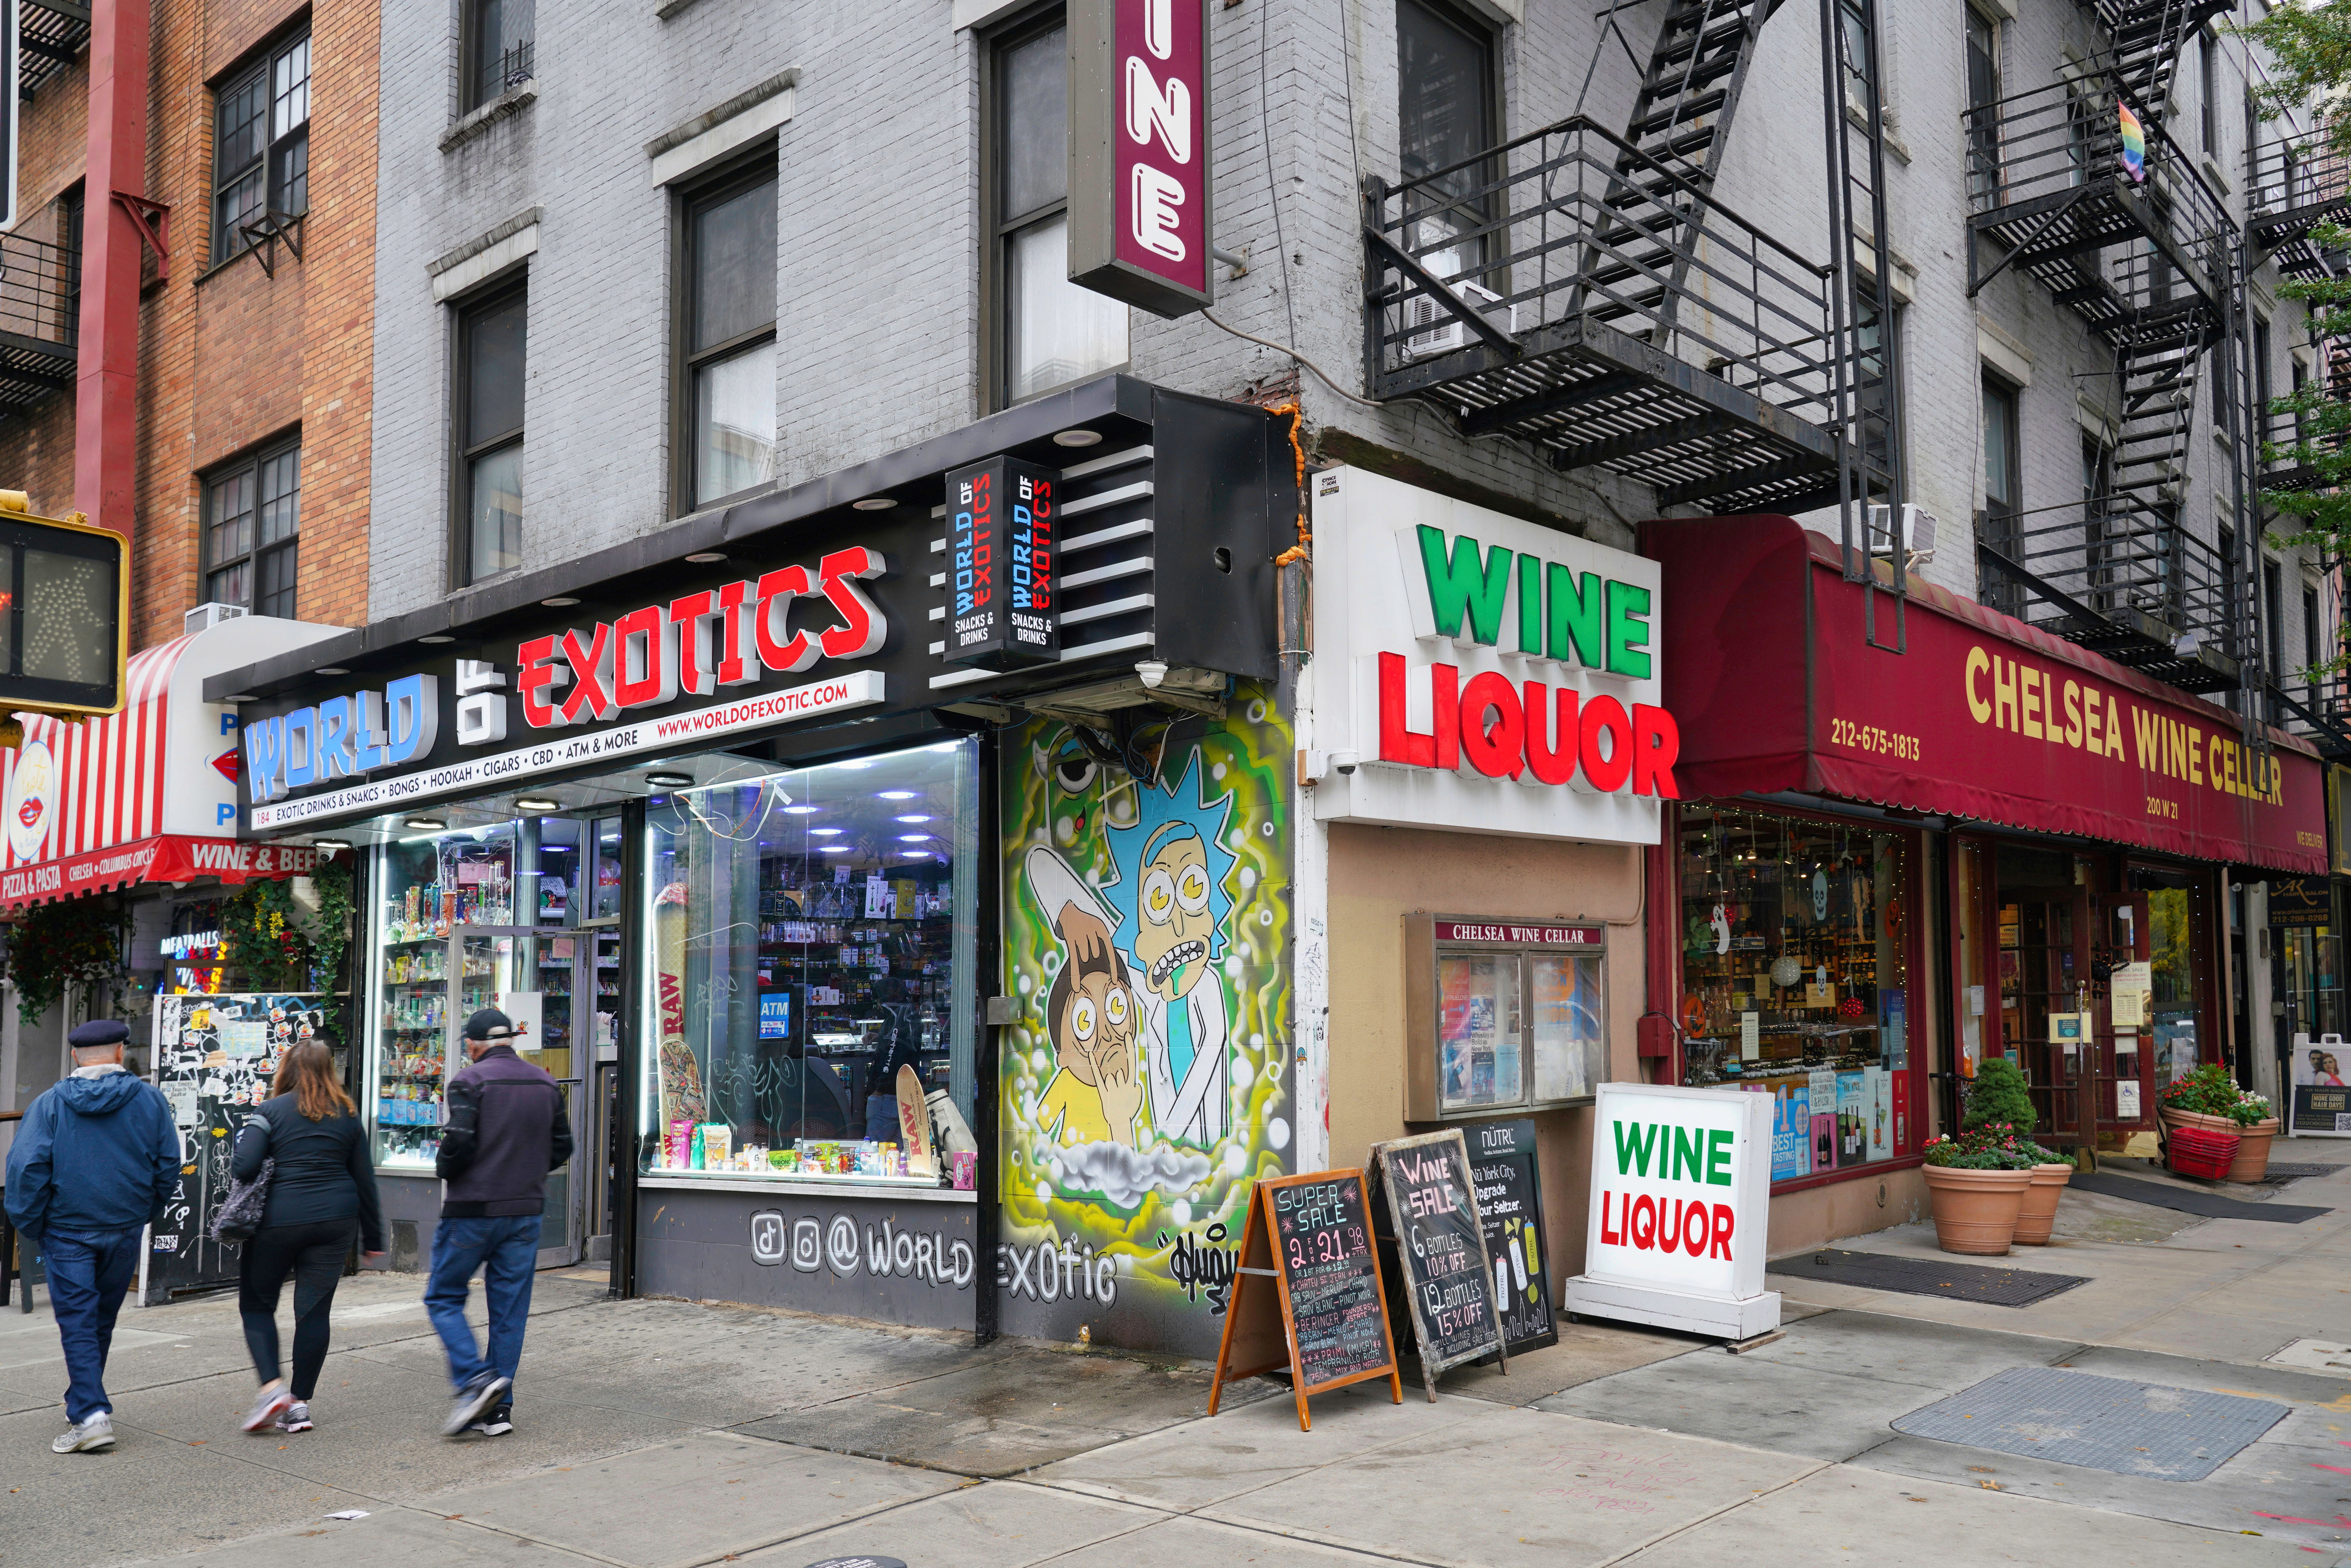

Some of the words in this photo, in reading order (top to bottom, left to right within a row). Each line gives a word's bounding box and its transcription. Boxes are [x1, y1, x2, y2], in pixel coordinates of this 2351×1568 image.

[1019, 475, 1032, 500] OF
[1322, 475, 1337, 484] SPACE
[960, 482, 972, 505] OF
[973, 473, 992, 607] EXOTICS
[1032, 479, 1051, 610] EXOTICS
[956, 511, 975, 616] WORLD
[1013, 504, 1032, 608] WORLD
[1416, 524, 1650, 679] WINE
[955, 614, 985, 633] SNACKS
[987, 612, 994, 625] &
[1012, 612, 1044, 630] SNACKS
[1045, 619, 1052, 632] &
[517, 546, 887, 728] EXOTICS
[960, 628, 988, 646] DRINKS
[1017, 628, 1046, 646] DRINKS
[657, 682, 848, 739] WWW.WORLDOFEXOTIC.COM
[244, 674, 438, 805] WORLD
[456, 658, 507, 746] OF
[1378, 651, 1680, 799] LIQUOR
[1965, 646, 2125, 762] CHELSEA
[2132, 705, 2202, 785] WINE
[2209, 735, 2283, 806] CELLAR
[1831, 718, 1920, 761] 212-675-1813
[256, 811, 270, 825] 184
[277, 802, 304, 822] EXOTIC
[307, 796, 337, 817] DRINKS
[338, 795, 345, 806] &
[347, 788, 379, 806] SNAKCS
[389, 779, 420, 798] BONGS
[430, 767, 473, 788] HOOKAH
[483, 756, 520, 776] CIGARS
[531, 751, 554, 766] CBD
[565, 741, 590, 759] ATM
[592, 738, 601, 753] &
[604, 729, 638, 749] MORE
[2146, 796, 2161, 816] 200
[2162, 800, 2170, 817] W
[2171, 802, 2178, 820] 21
[2296, 830, 2305, 846] WE
[2305, 832, 2323, 849] DELIVER
[193, 843, 252, 870] WINE
[256, 848, 273, 871] &
[280, 847, 324, 873] BEE
[3, 873, 26, 899] PIZZA
[27, 872, 35, 893] &
[36, 865, 61, 892] PASTA
[69, 862, 93, 882] CHELSEA
[99, 853, 131, 875] COLUMBUS
[132, 848, 155, 868] CIRCLE
[2272, 907, 2328, 915] www.arhairsalon.com
[2272, 914, 2328, 923] 212-206-0268
[1453, 924, 1505, 941] CHELSEA
[1511, 927, 1540, 942] WINE
[1545, 929, 1585, 943] CELLAR
[659, 971, 685, 1036] RAW
[761, 1002, 788, 1016] ATM
[1842, 1081, 1850, 1092] THE
[1774, 1087, 1789, 1132] #1
[1814, 1097, 1818, 1107] &
[900, 1100, 922, 1157] RAW
[1613, 1120, 1734, 1187] WINE
[1773, 1133, 1794, 1152] BEST
[1773, 1150, 1794, 1163] TASTING
[1398, 1153, 1451, 1185] WINE
[1483, 1164, 1499, 1181] York
[1499, 1164, 1516, 1181] City,
[1278, 1184, 1339, 1211] SUPER
[1409, 1184, 1457, 1219] SALE
[1493, 1200, 1522, 1214] Seltzer.
[1298, 1204, 1347, 1231] SALE
[1488, 1221, 1501, 1230] Seltzer.
[1600, 1190, 1734, 1261] LIQUOR
[1412, 1225, 1425, 1258] 6
[1426, 1232, 1463, 1255] BOTTLES
[1485, 1231, 1495, 1239] Juice.
[1290, 1238, 1307, 1269] 2
[1352, 1248, 1368, 1258] +TAX
[1426, 1255, 1448, 1277] 10%
[1449, 1251, 1466, 1271] OFF
[1295, 1269, 1303, 1278] OR
[1303, 1268, 1308, 1277] 1
[1308, 1268, 1314, 1276] BT
[1315, 1266, 1325, 1274] FOR
[1297, 1278, 1318, 1291] CHATEU
[1320, 1275, 1328, 1285] ST
[1329, 1271, 1346, 1284] JEAN
[1291, 1293, 1301, 1304] CAB
[1424, 1284, 1446, 1316] 12
[1444, 1279, 1482, 1308] BOTTLES
[1298, 1305, 1314, 1318] SAUV
[1301, 1312, 1339, 1332] BERINGER
[1347, 1311, 1367, 1322] ESTATE
[1437, 1308, 1462, 1337] 15%
[1463, 1302, 1482, 1326] OFF
[1297, 1331, 1308, 1342] CAB
[1304, 1341, 1319, 1352] SAUV
[1321, 1336, 1337, 1349] BLANC
[1343, 1331, 1359, 1342] PINOT
[1446, 1338, 1471, 1355] INCLUDING
[1472, 1334, 1483, 1346] SALE
[1485, 1329, 1497, 1343] ITEMS
[1451, 1329, 1471, 1343] WINES
[1312, 1354, 1361, 1372] TEMPRANILLO
[1364, 1349, 1380, 1361] RIOJA
[1321, 1346, 1345, 1361] PRIMI
[1347, 1339, 1373, 1357] (MUGA)
[1335, 1365, 1348, 1375] MIX
[1350, 1363, 1361, 1373] AND
[1363, 1358, 1385, 1371] MATCH.
